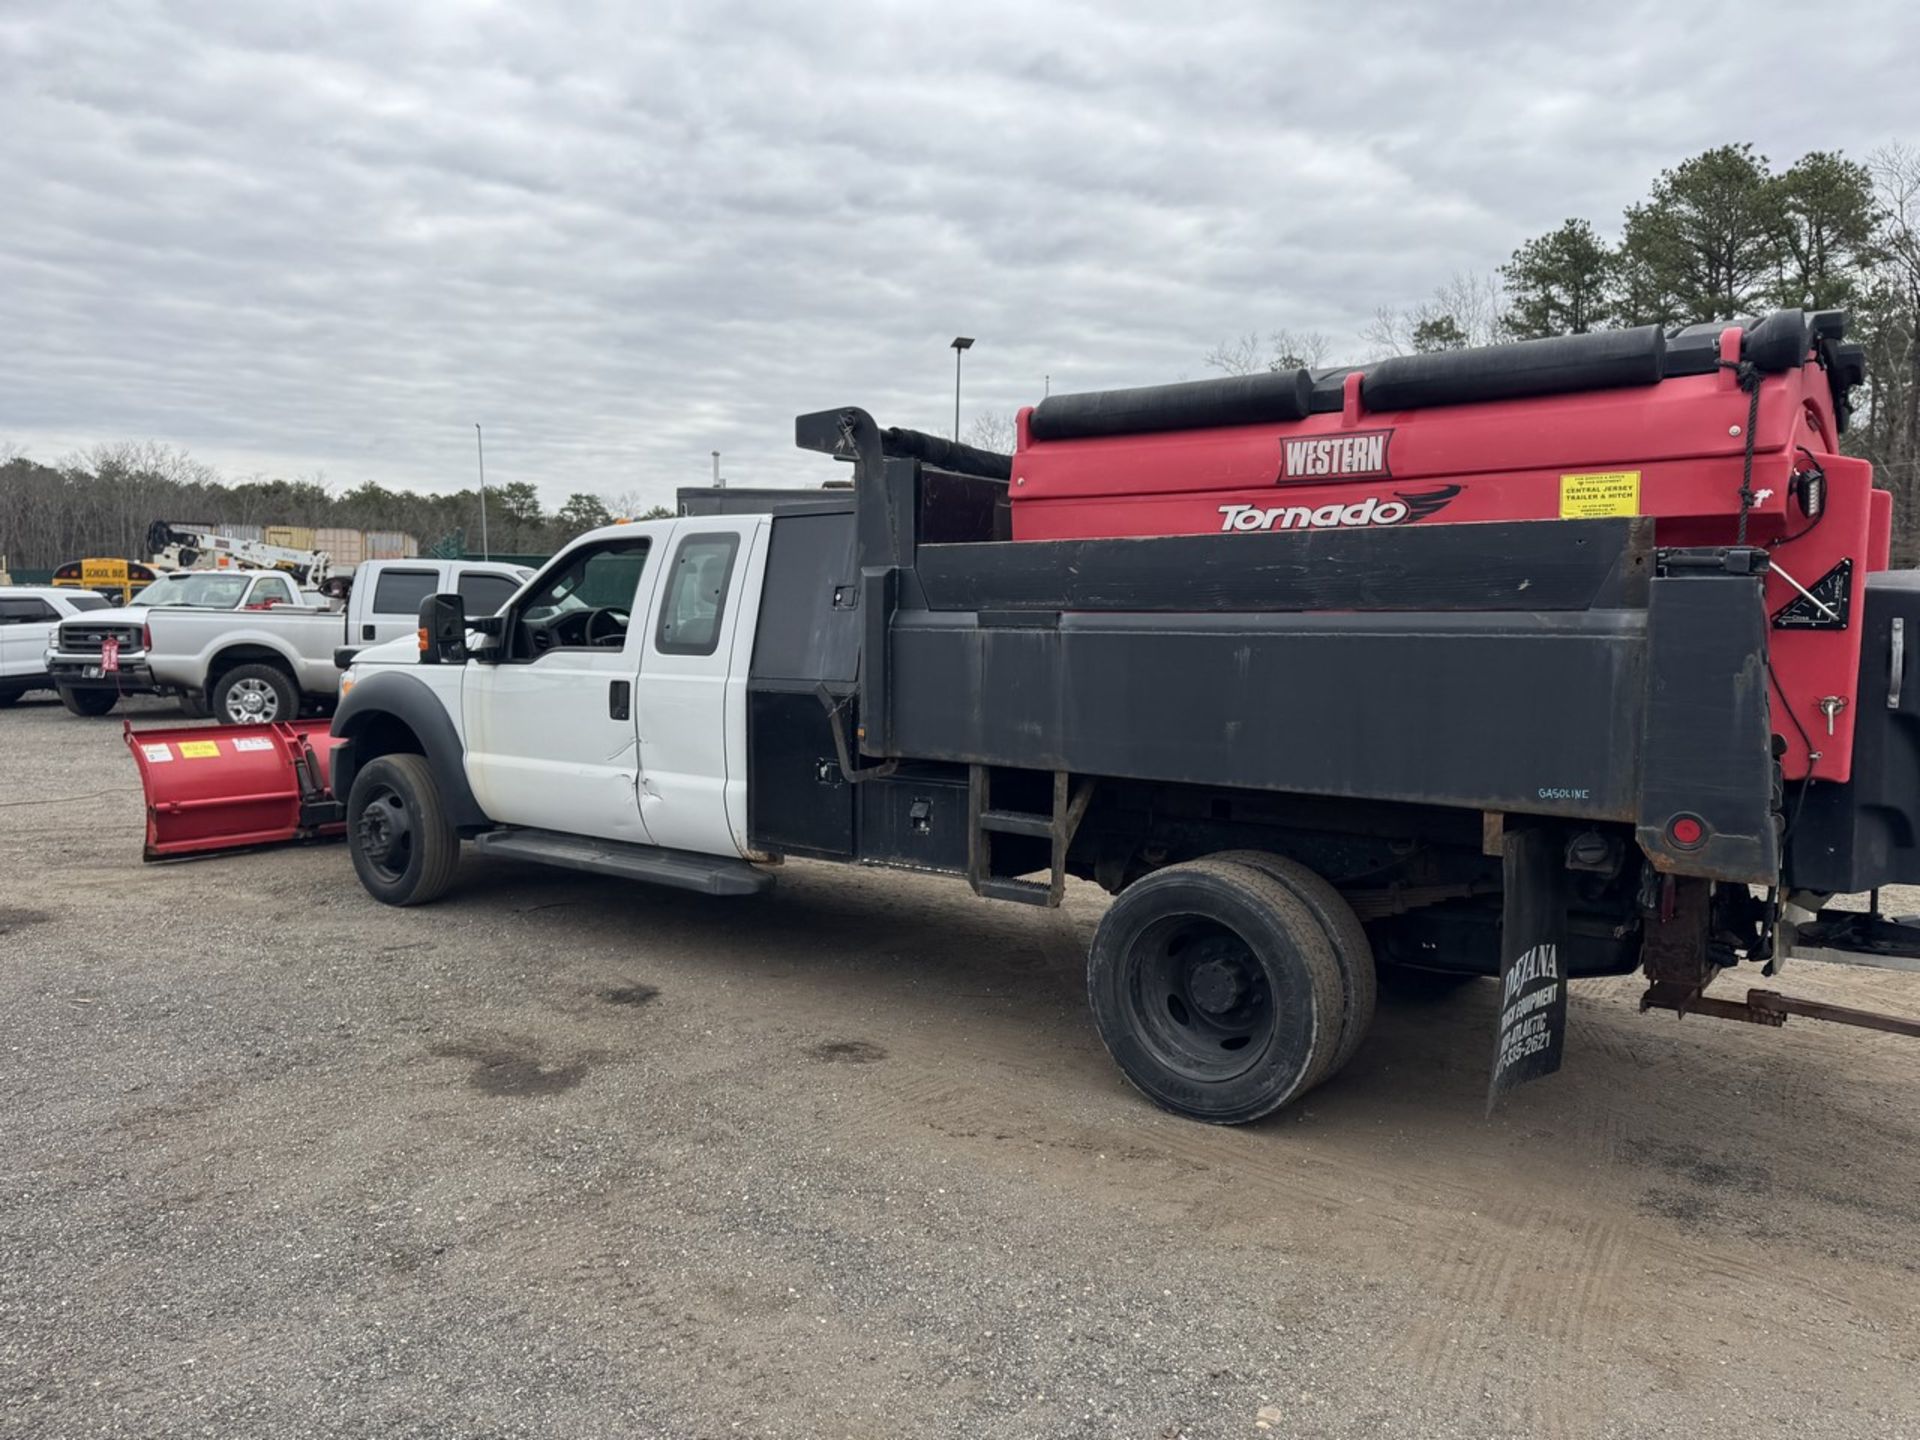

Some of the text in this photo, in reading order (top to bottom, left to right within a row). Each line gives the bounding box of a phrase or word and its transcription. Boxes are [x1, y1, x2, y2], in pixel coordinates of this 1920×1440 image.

[1286, 436, 1383, 476] WESTERN
[1218, 498, 1407, 531] Tornado
[86, 568, 125, 577] SCHOOL BUS
[1538, 788, 1590, 800] GASOLINE
